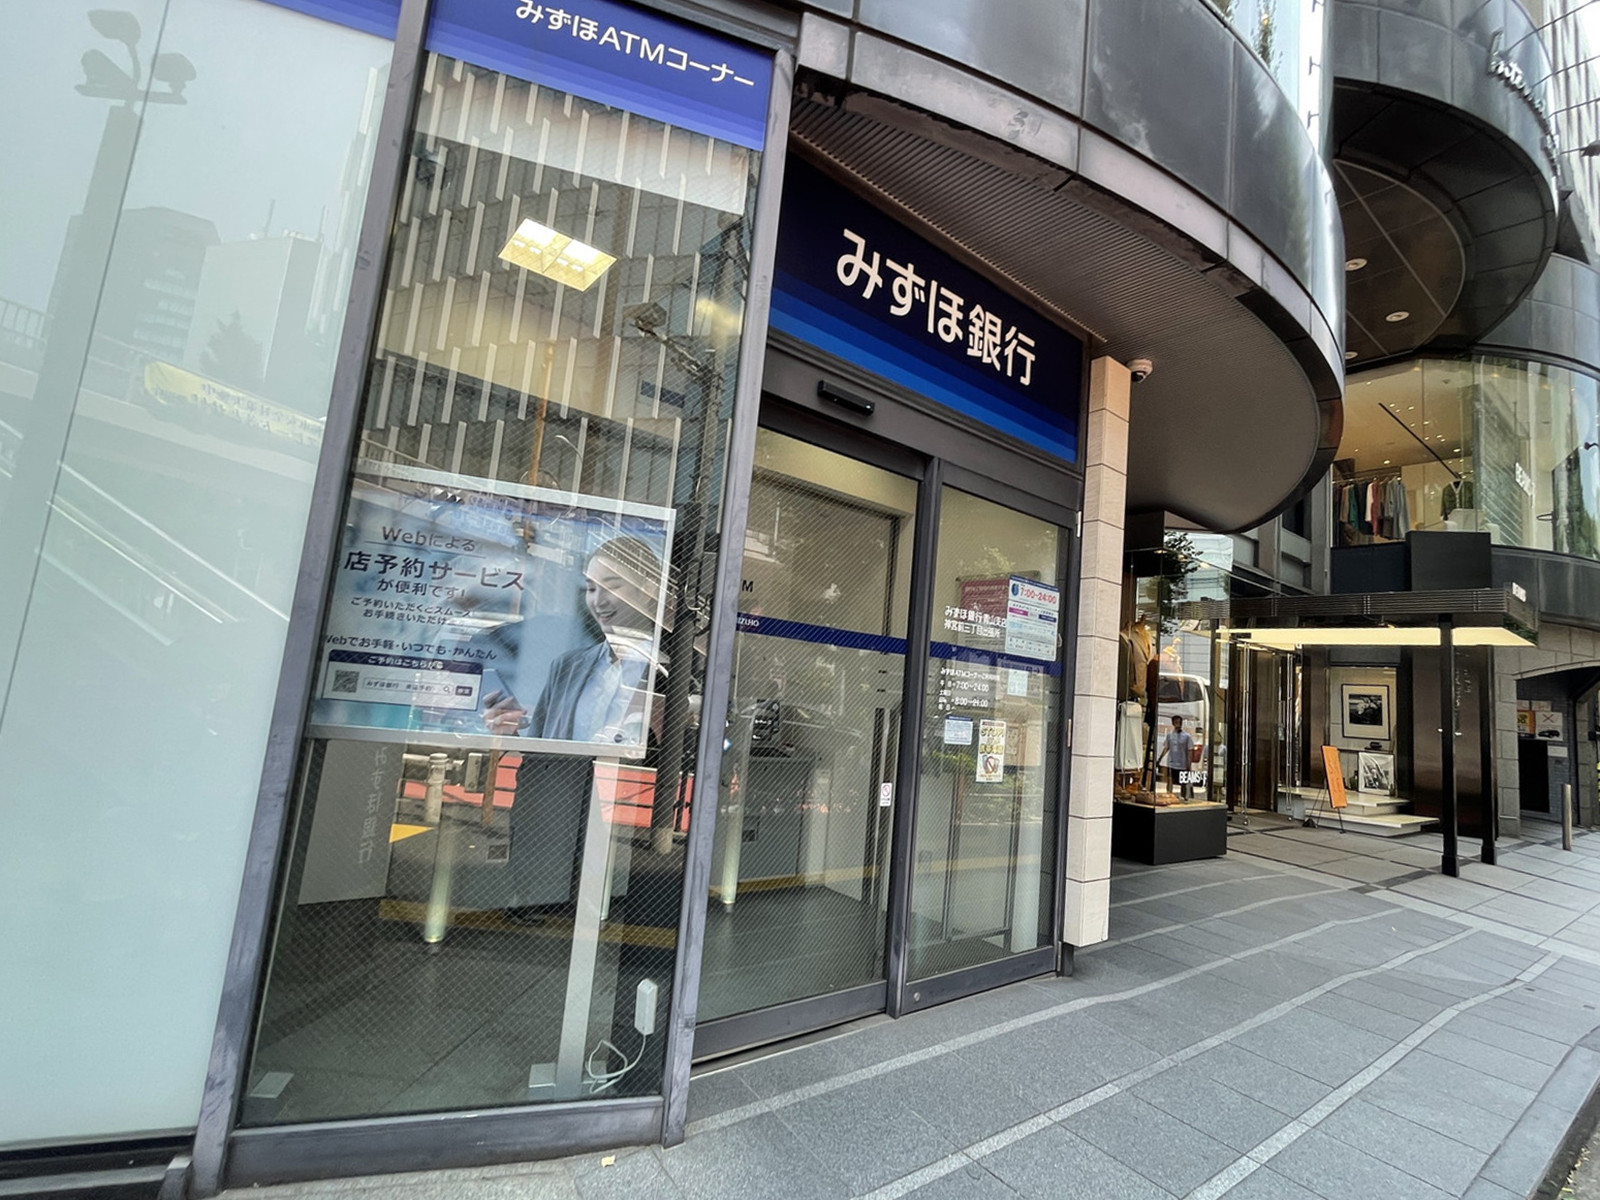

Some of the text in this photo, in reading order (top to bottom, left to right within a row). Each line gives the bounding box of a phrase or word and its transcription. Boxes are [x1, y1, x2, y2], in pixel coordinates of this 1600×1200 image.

[516, 0, 754, 86] みずほATMコーナー
[837, 228, 1036, 386] みずほ銀行
[382, 525, 477, 552] Webによる
[343, 550, 526, 591] 店予約サービス
[1179, 770, 1201, 784] BEAMS
